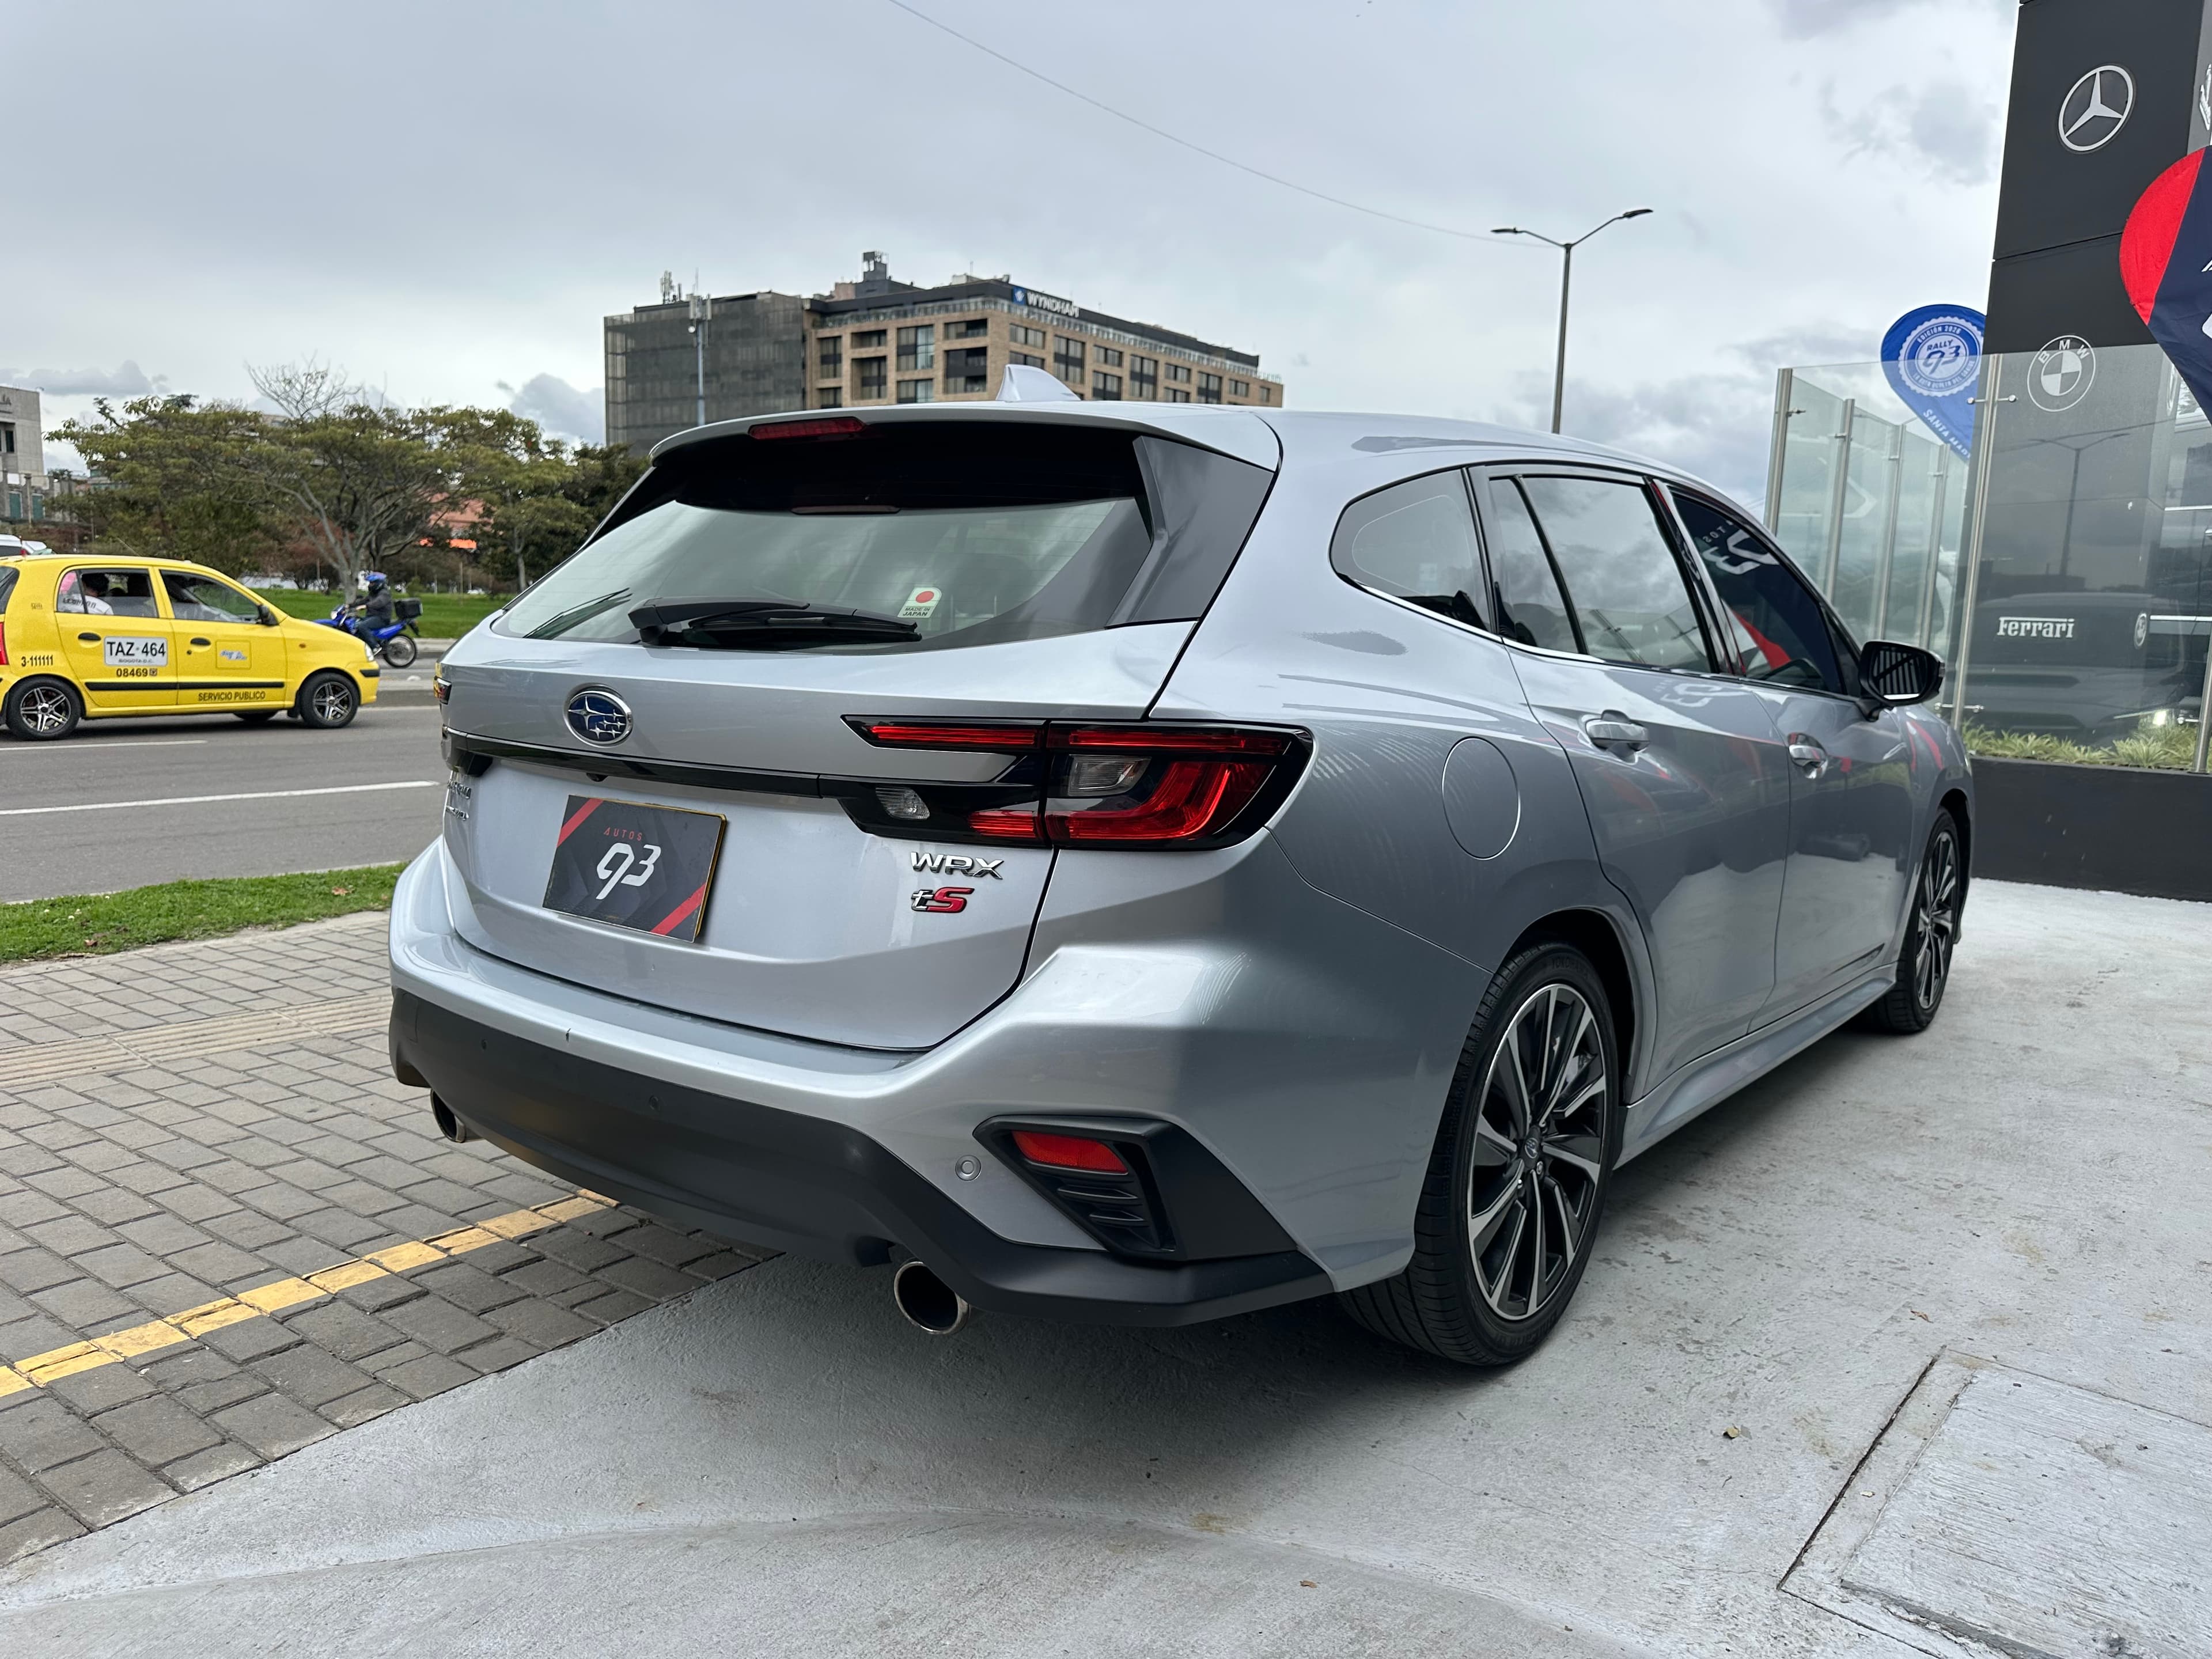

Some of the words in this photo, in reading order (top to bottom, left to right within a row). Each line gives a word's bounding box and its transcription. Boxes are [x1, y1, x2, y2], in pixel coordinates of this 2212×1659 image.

[1027, 291, 1079, 318] WYNDHAM
[1927, 339, 1953, 351] RALLY
[2038, 339, 2090, 363] BMW
[1923, 346, 1960, 374] 93
[1923, 408, 1949, 437] SANTA
[1997, 616, 2075, 638] Ferrari
[116, 668, 148, 677] 08469
[198, 692, 233, 702] SERVICIO
[234, 691, 266, 700] PUBLICO
[603, 827, 643, 841] AUTOS
[596, 842, 661, 900] 93
[910, 851, 1004, 880] WRX
[911, 887, 975, 914] tS
